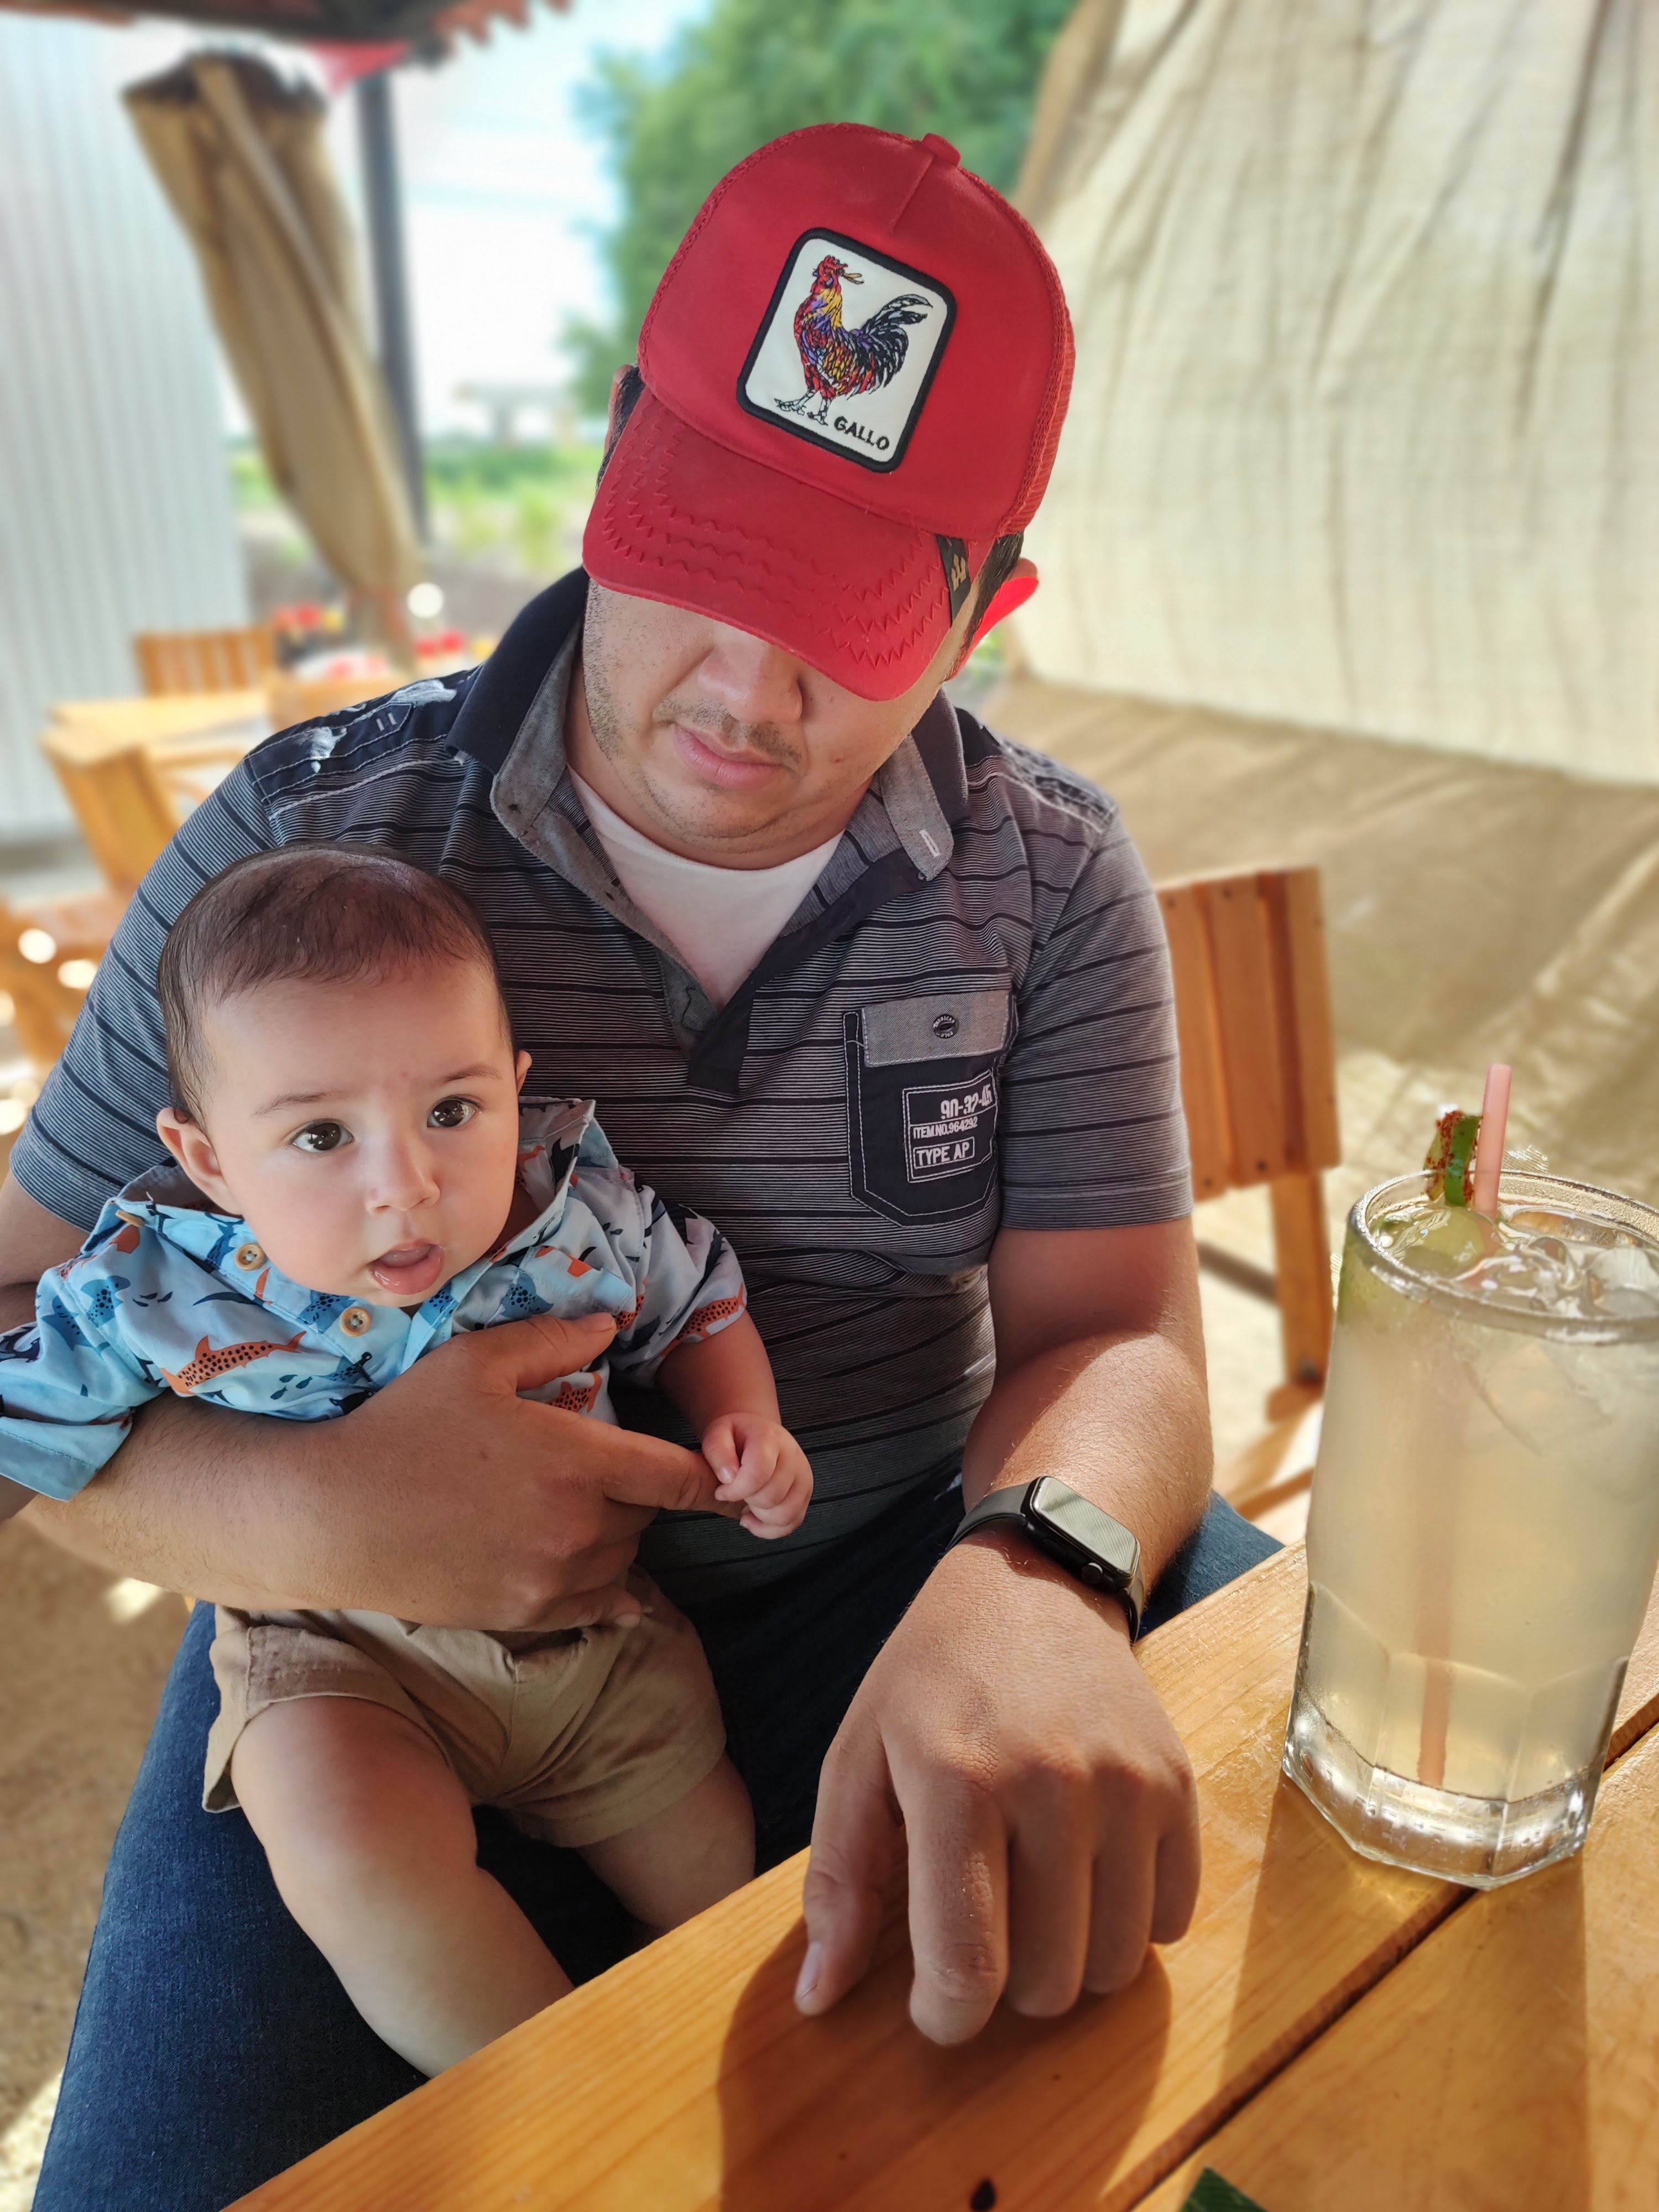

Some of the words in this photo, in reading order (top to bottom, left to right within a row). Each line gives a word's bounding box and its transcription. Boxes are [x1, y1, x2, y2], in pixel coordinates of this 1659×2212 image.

[834, 416, 890, 450] GALLO
[916, 1146, 950, 1166] TYPE
[953, 1142, 970, 1160] AP
